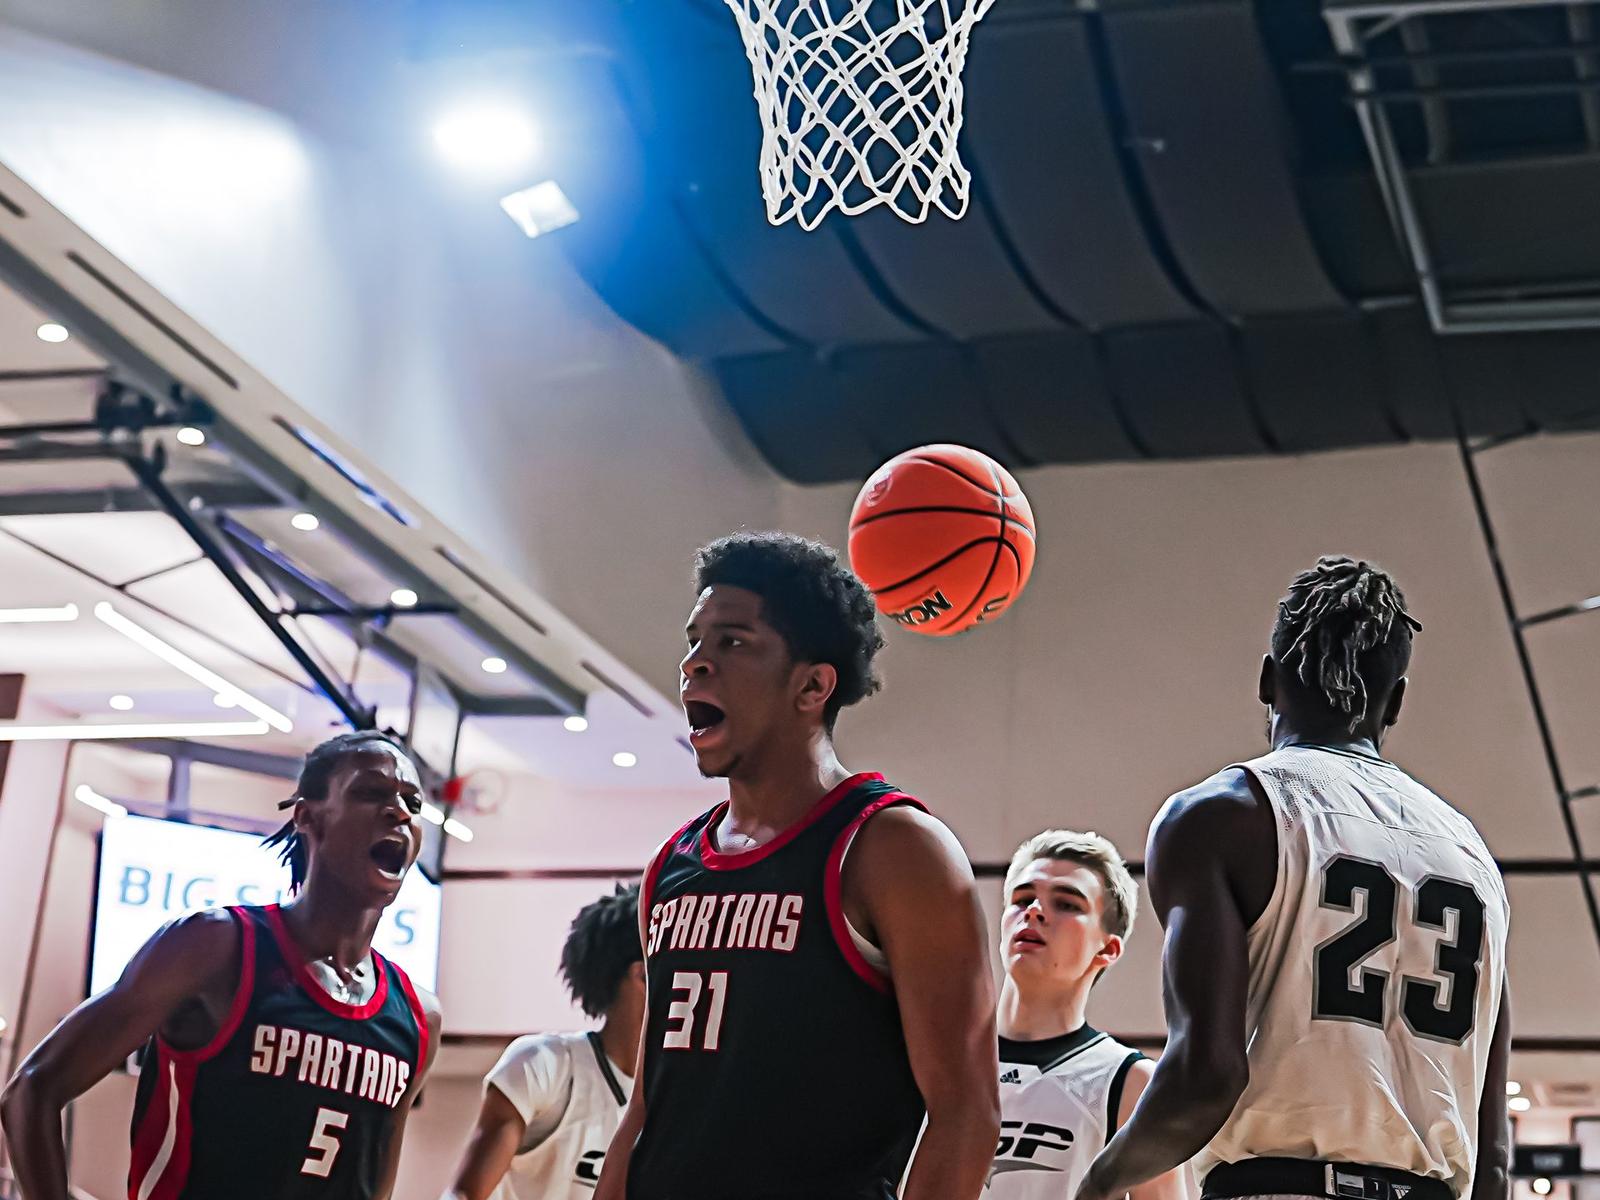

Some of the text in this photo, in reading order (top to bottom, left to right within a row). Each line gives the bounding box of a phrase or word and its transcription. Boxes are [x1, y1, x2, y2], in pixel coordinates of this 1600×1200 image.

[119, 866, 214, 910] BIG
[648, 893, 804, 957] SPARTANS
[1311, 852, 1487, 1047] 23
[662, 971, 729, 1051] 31
[250, 1024, 410, 1109] SPARTANS
[300, 1107, 350, 1178] 5
